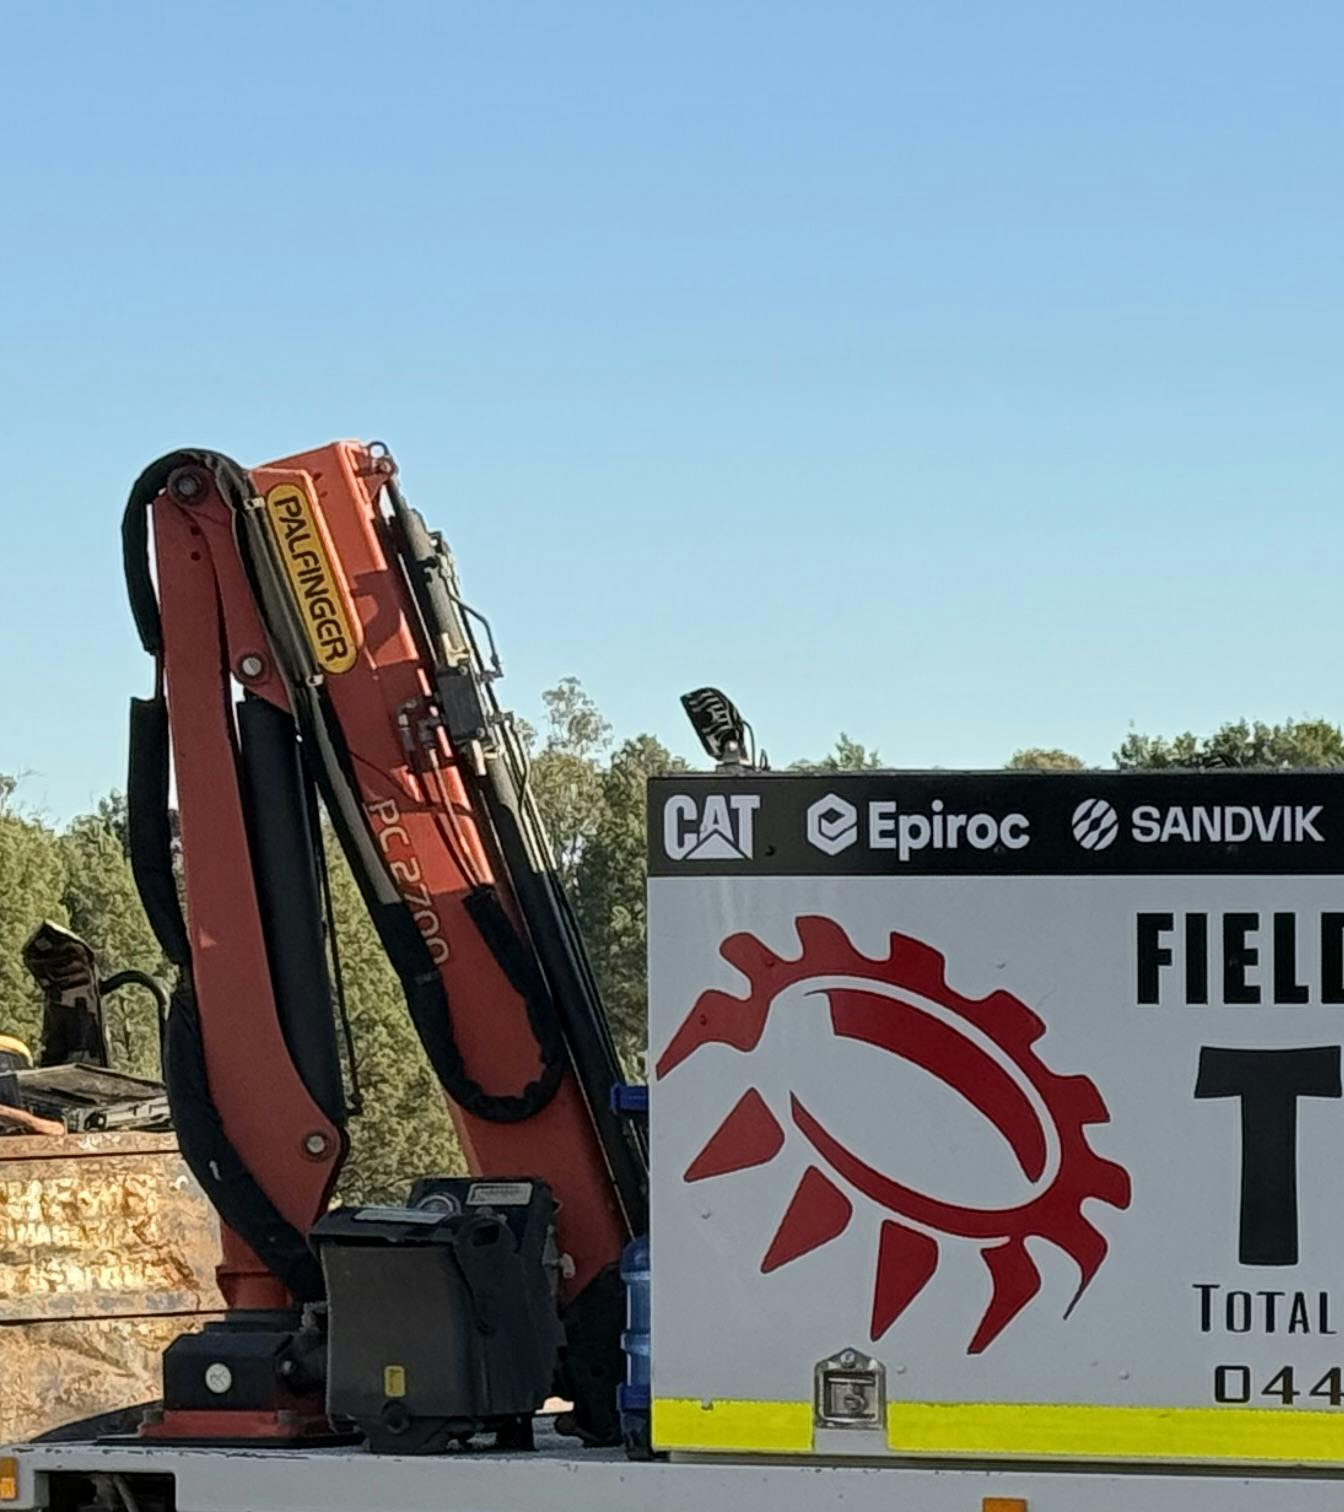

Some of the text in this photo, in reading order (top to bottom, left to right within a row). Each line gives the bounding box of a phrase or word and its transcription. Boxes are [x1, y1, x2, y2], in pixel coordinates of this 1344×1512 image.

[273, 494, 348, 664] PALFINGER
[663, 794, 761, 861] CAT
[868, 799, 1030, 862] Epiroc
[1131, 805, 1326, 844] SANDVIK
[369, 798, 450, 964] PC 2700
[1192, 1283, 1336, 1335] TOTAL
